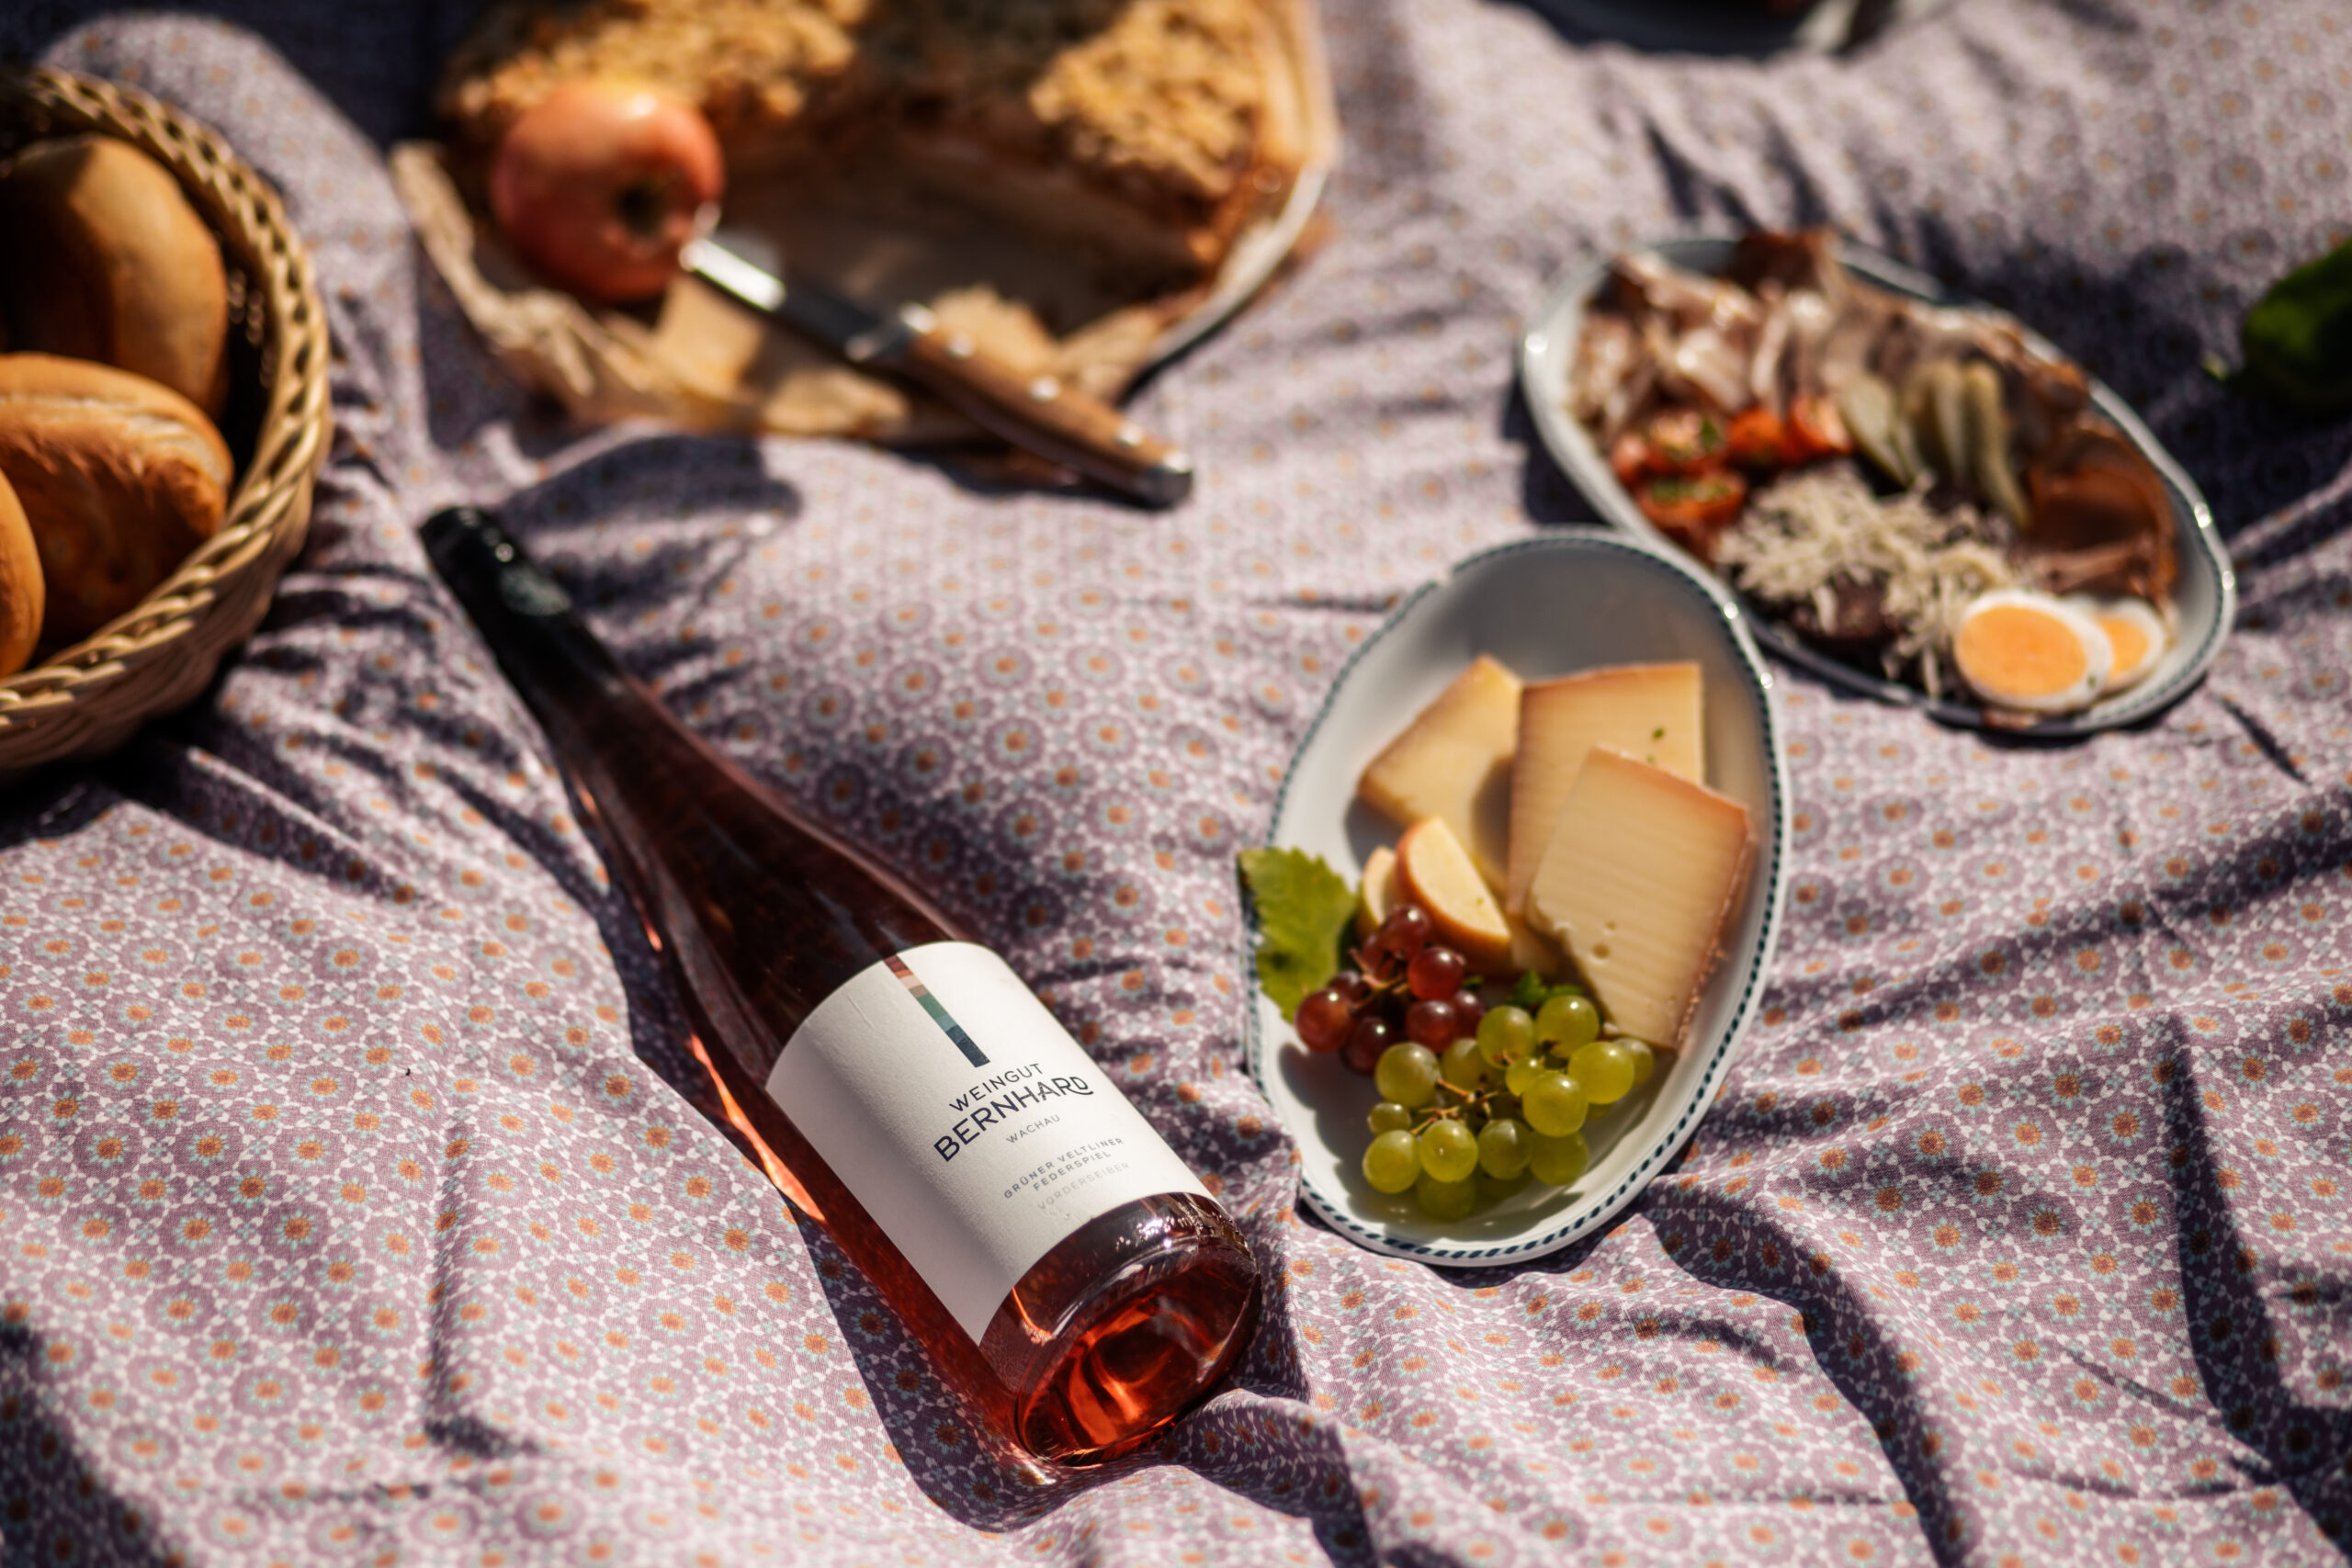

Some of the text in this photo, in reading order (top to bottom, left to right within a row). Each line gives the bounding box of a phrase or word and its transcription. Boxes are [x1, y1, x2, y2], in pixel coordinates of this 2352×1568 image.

[949, 1063, 1044, 1111] WEINGUT
[933, 1077, 1094, 1162] BERNHARD
[1006, 1114, 1061, 1144] WACHAU
[1004, 1137, 1124, 1199] GRÜNER VELTLINER
[1033, 1151, 1112, 1191] FEDERSPIEL
